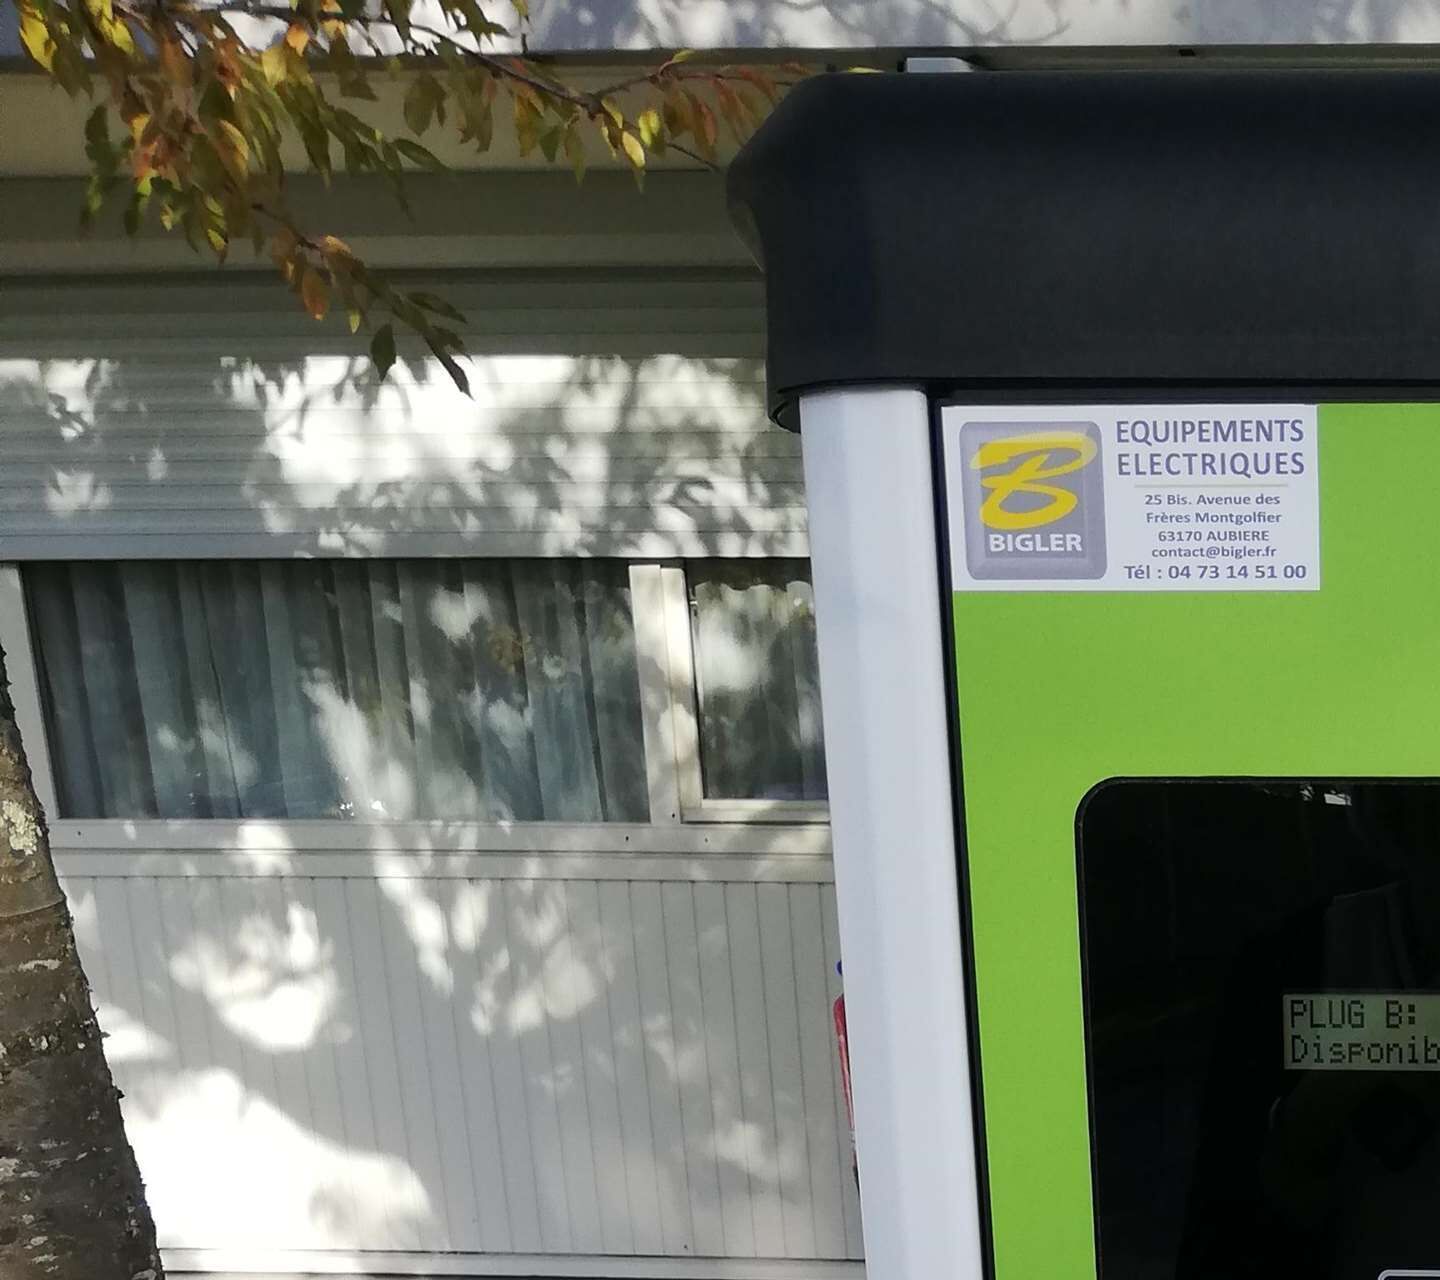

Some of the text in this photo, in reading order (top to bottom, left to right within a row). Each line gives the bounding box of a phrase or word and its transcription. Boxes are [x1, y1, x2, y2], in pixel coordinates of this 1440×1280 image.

[1116, 419, 1304, 445] EQUIPEMENTS
[1117, 452, 1305, 477] ELECTRIQUES
[1144, 494, 1280, 505] 25 Bis. Avenue des
[1147, 512, 1282, 528] Frères Montgolfier
[989, 533, 1083, 552] BIGLER
[1158, 531, 1269, 542] 63170 AUBIERE
[1152, 546, 1277, 559] contact@bigler.fr
[1124, 565, 1151, 579] Tél
[1168, 566, 1191, 579] 04
[1197, 566, 1220, 579] 73
[1226, 566, 1248, 579] 14
[1255, 566, 1277, 579] 51
[1283, 566, 1306, 579] 00
[1290, 1000, 1419, 1030] PLUG B:
